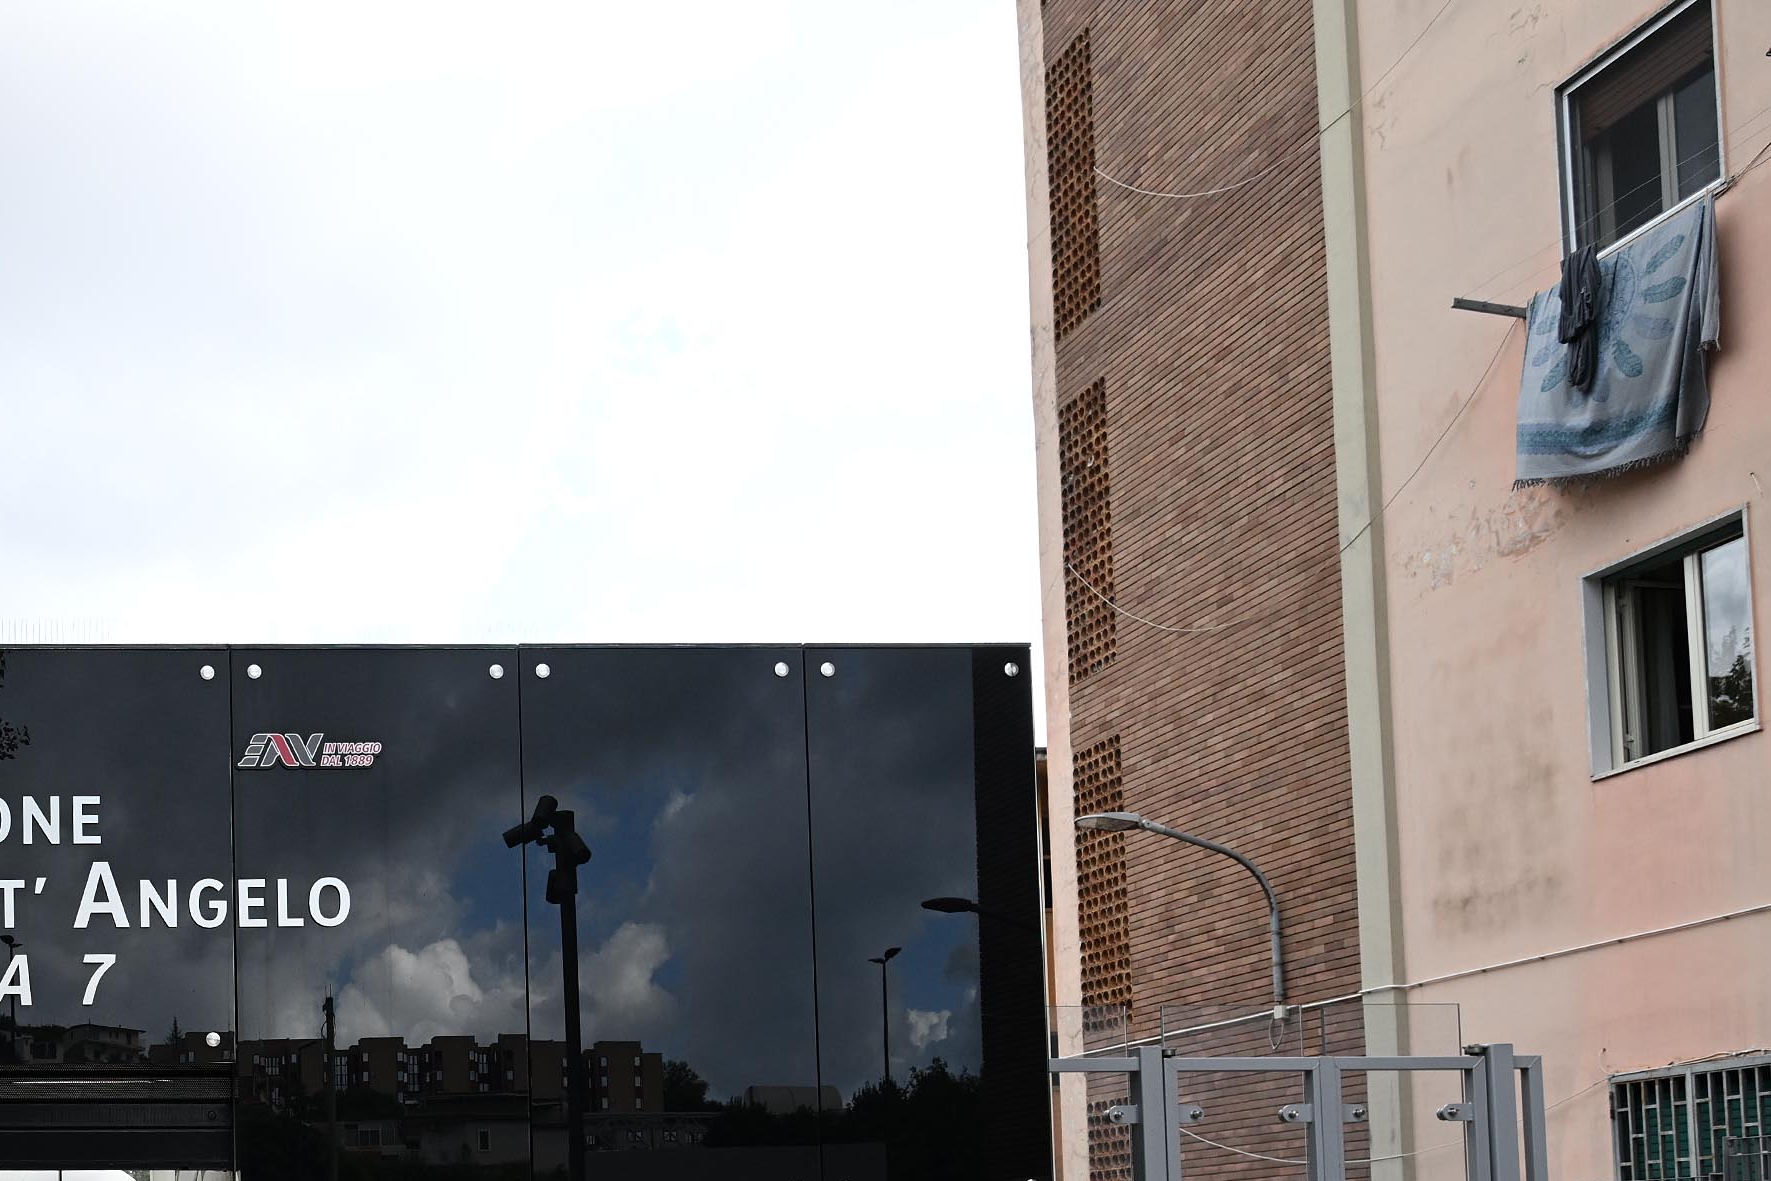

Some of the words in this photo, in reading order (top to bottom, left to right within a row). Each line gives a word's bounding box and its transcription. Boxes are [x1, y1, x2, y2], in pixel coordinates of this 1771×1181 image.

[320, 755, 342, 766] DAL
[344, 755, 374, 766] 1889
[323, 743, 335, 754] IN
[336, 743, 382, 754] VIAGGIO
[73, 861, 351, 930] ANGELO
[82, 954, 117, 1005] 7
